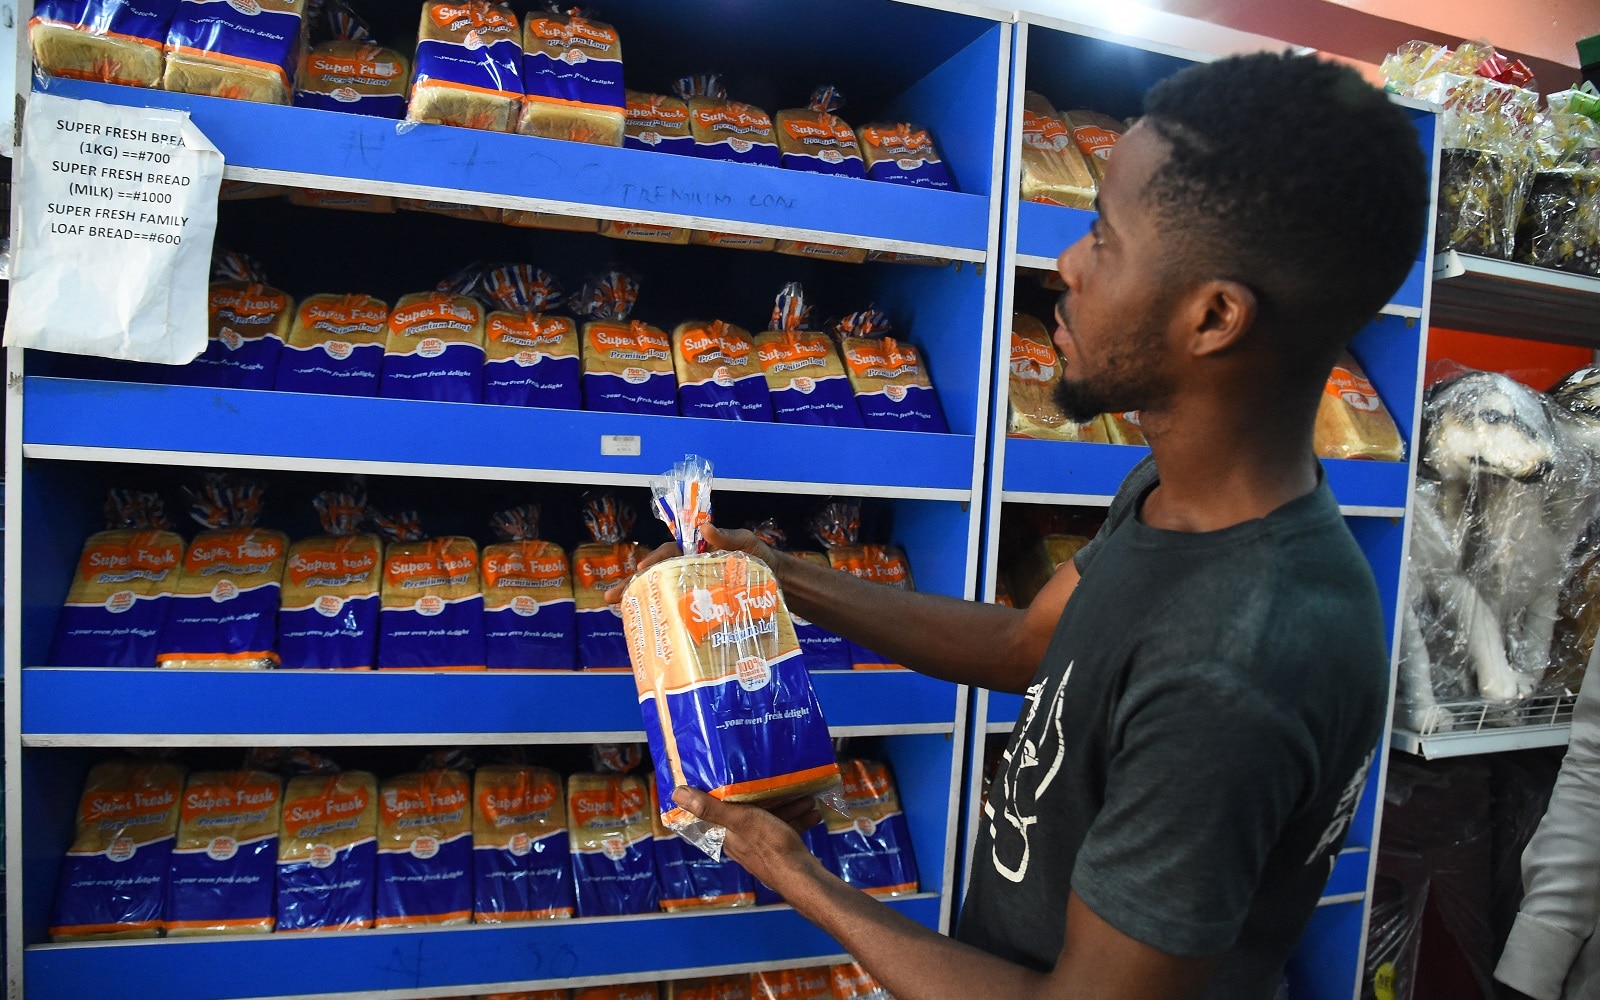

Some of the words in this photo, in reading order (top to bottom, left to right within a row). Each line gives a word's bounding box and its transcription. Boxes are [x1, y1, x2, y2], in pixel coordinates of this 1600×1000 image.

[258, 30, 284, 40] delight
[576, 25, 613, 41] Fresh
[315, 60, 356, 74] Super
[626, 108, 651, 119] uper
[56, 120, 101, 135] SUPER
[105, 126, 147, 143] FRESH
[151, 133, 186, 148] BREA
[792, 124, 827, 137] Super
[1077, 133, 1107, 145] Super
[79, 141, 118, 160] (1KG)
[122, 151, 171, 164] ==#700
[52, 160, 97, 176] SUPER
[101, 167, 143, 182] FRESH
[147, 173, 190, 186] BREAD
[69, 183, 113, 200] (MILK)
[118, 191, 172, 204] ==#1000
[47, 203, 90, 218] SUPER
[95, 208, 135, 221] FRESH
[140, 213, 189, 227] FAMILY
[51, 223, 85, 236] LOAF
[89, 226, 181, 245] BREAD==#600
[351, 309, 387, 319] Fresh
[395, 308, 435, 324] Super
[405, 322, 448, 336] Premium
[448, 321, 472, 332] Loaf
[533, 321, 565, 334] Fesh
[597, 332, 636, 346] Super
[610, 349, 648, 360] Premium
[648, 349, 668, 360] Loaf
[854, 351, 887, 365] Super
[295, 559, 337, 572] Super
[390, 561, 432, 575] Super
[487, 560, 527, 577] Super
[530, 559, 567, 573] Fresh
[583, 563, 620, 578] Super
[401, 578, 447, 589] Premium
[498, 579, 539, 587] Premium
[540, 577, 564, 586] Loaf
[735, 590, 777, 612] Fresh
[648, 571, 663, 618] Super
[658, 617, 673, 665] Fresh
[427, 629, 445, 637] fresh
[765, 711, 782, 724] fresh
[784, 707, 809, 718] delight
[135, 792, 173, 806] Fresh
[187, 794, 231, 810] Super
[237, 789, 274, 805] Fresh
[578, 801, 614, 814] Super
